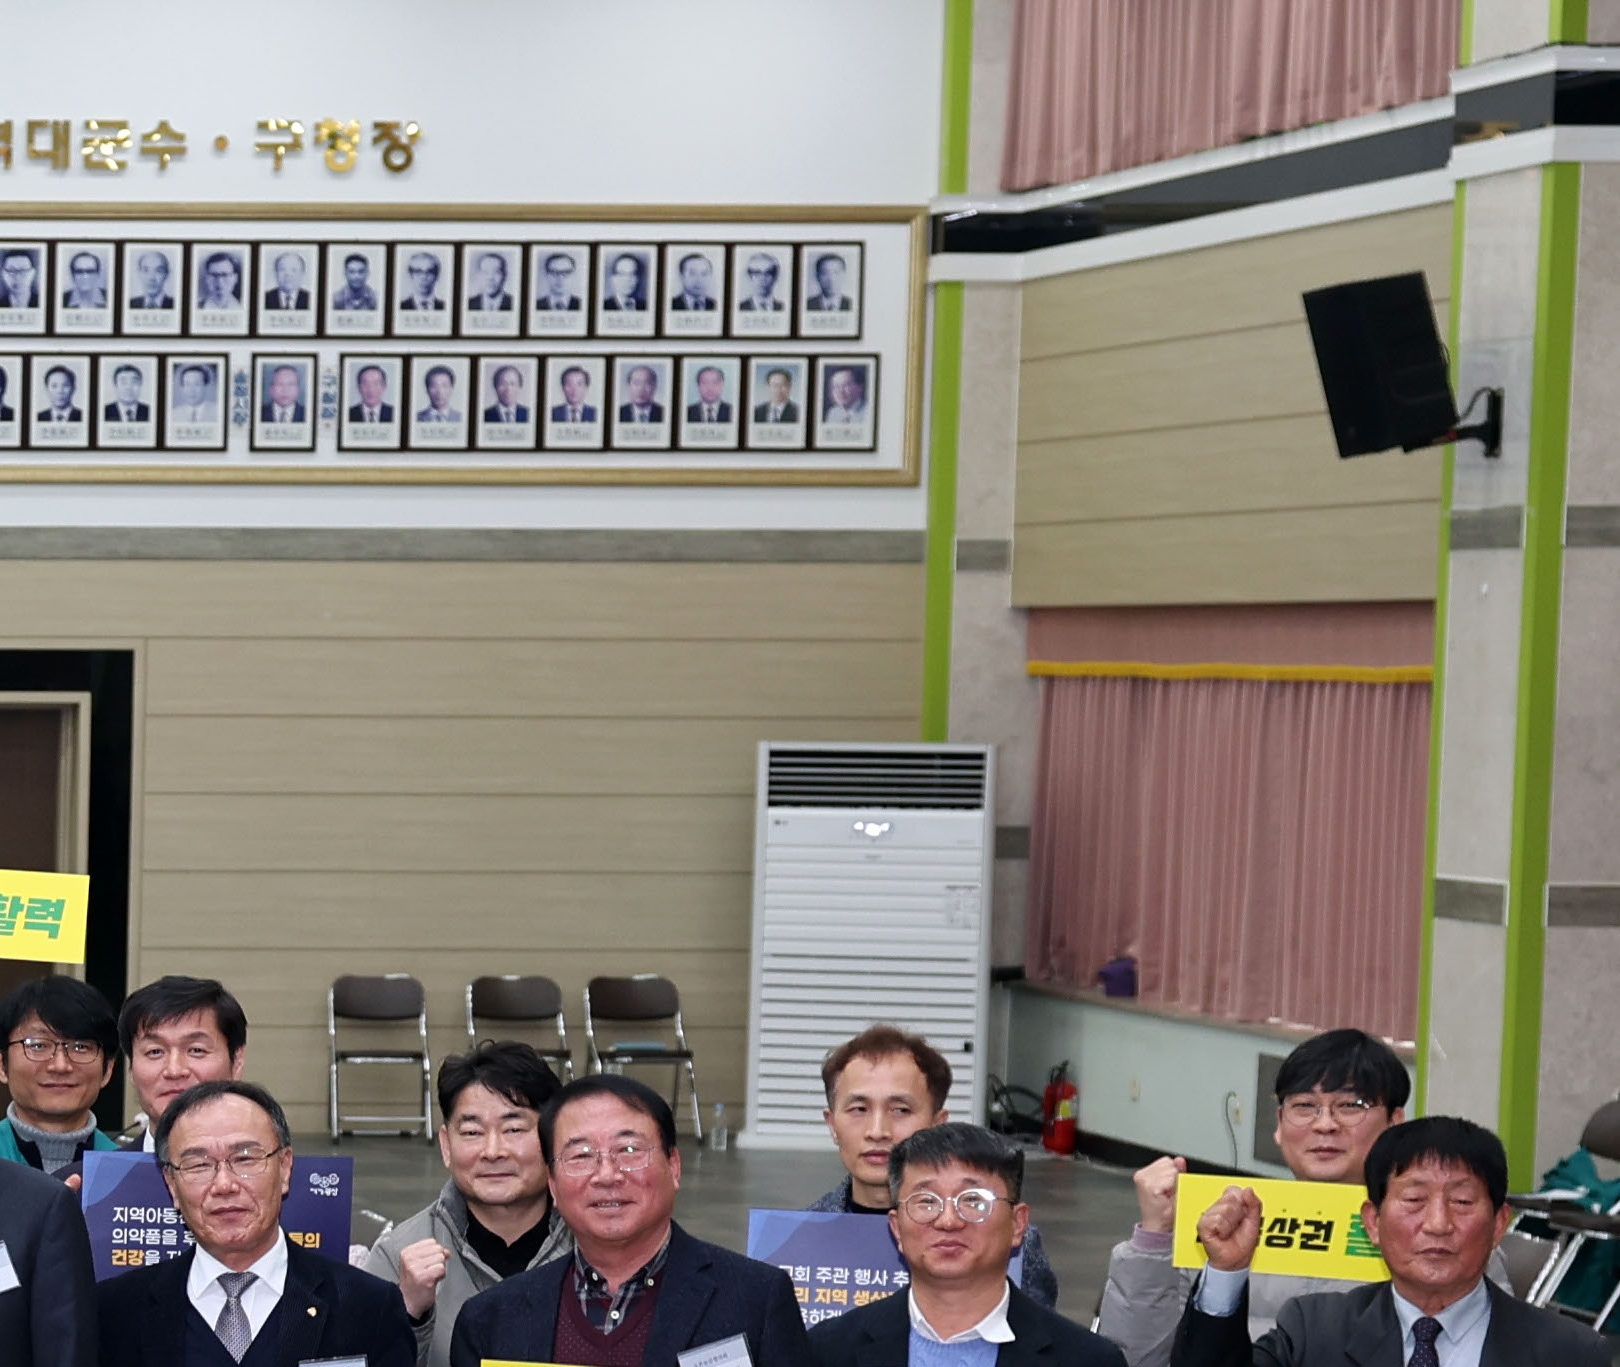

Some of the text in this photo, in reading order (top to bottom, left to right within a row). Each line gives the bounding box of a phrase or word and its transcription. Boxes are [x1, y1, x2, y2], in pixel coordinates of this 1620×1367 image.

[254, 117, 426, 174] 구청장
[112, 1228, 178, 1246] 의약품을
[816, 1266, 889, 1287] 주관 행사
[814, 1288, 849, 1306] 지역
